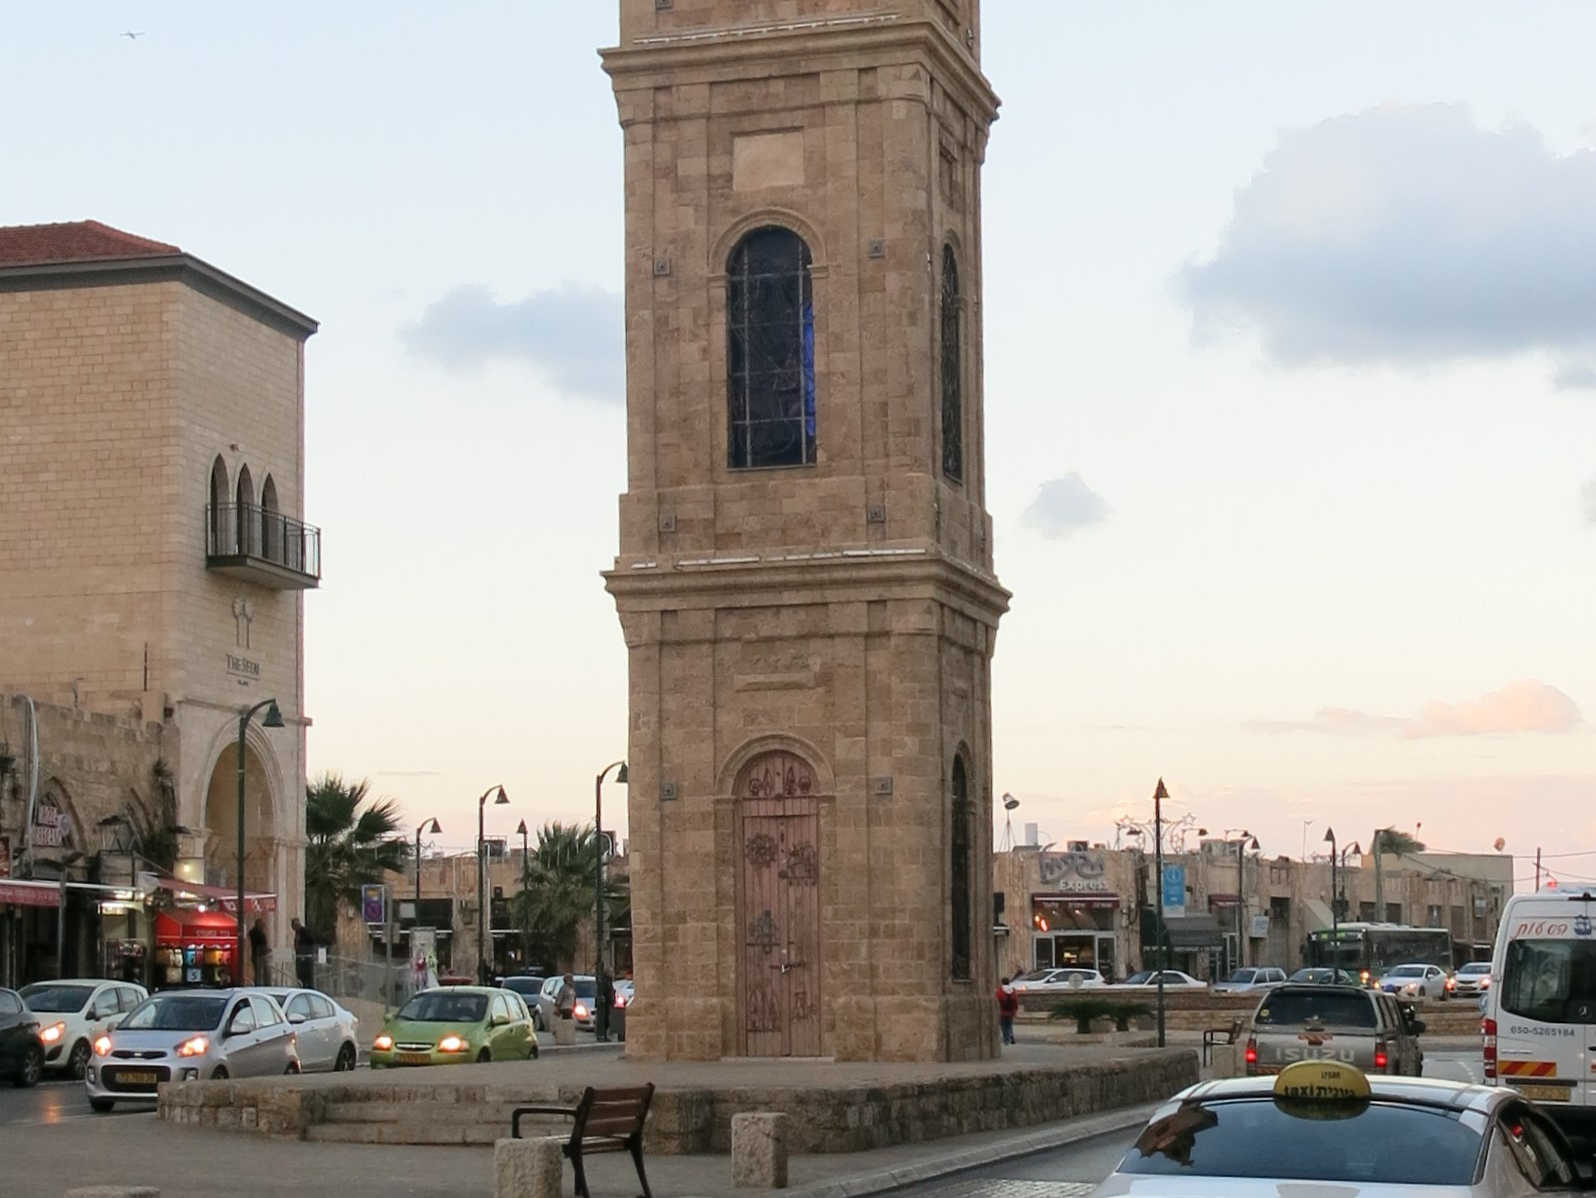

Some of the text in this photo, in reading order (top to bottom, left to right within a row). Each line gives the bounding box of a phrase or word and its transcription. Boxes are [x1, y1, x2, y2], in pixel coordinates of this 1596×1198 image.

[1060, 880, 1109, 892] Express
[1276, 1048, 1355, 1062] ISUZU
[1284, 1084, 1314, 1097] taxi
